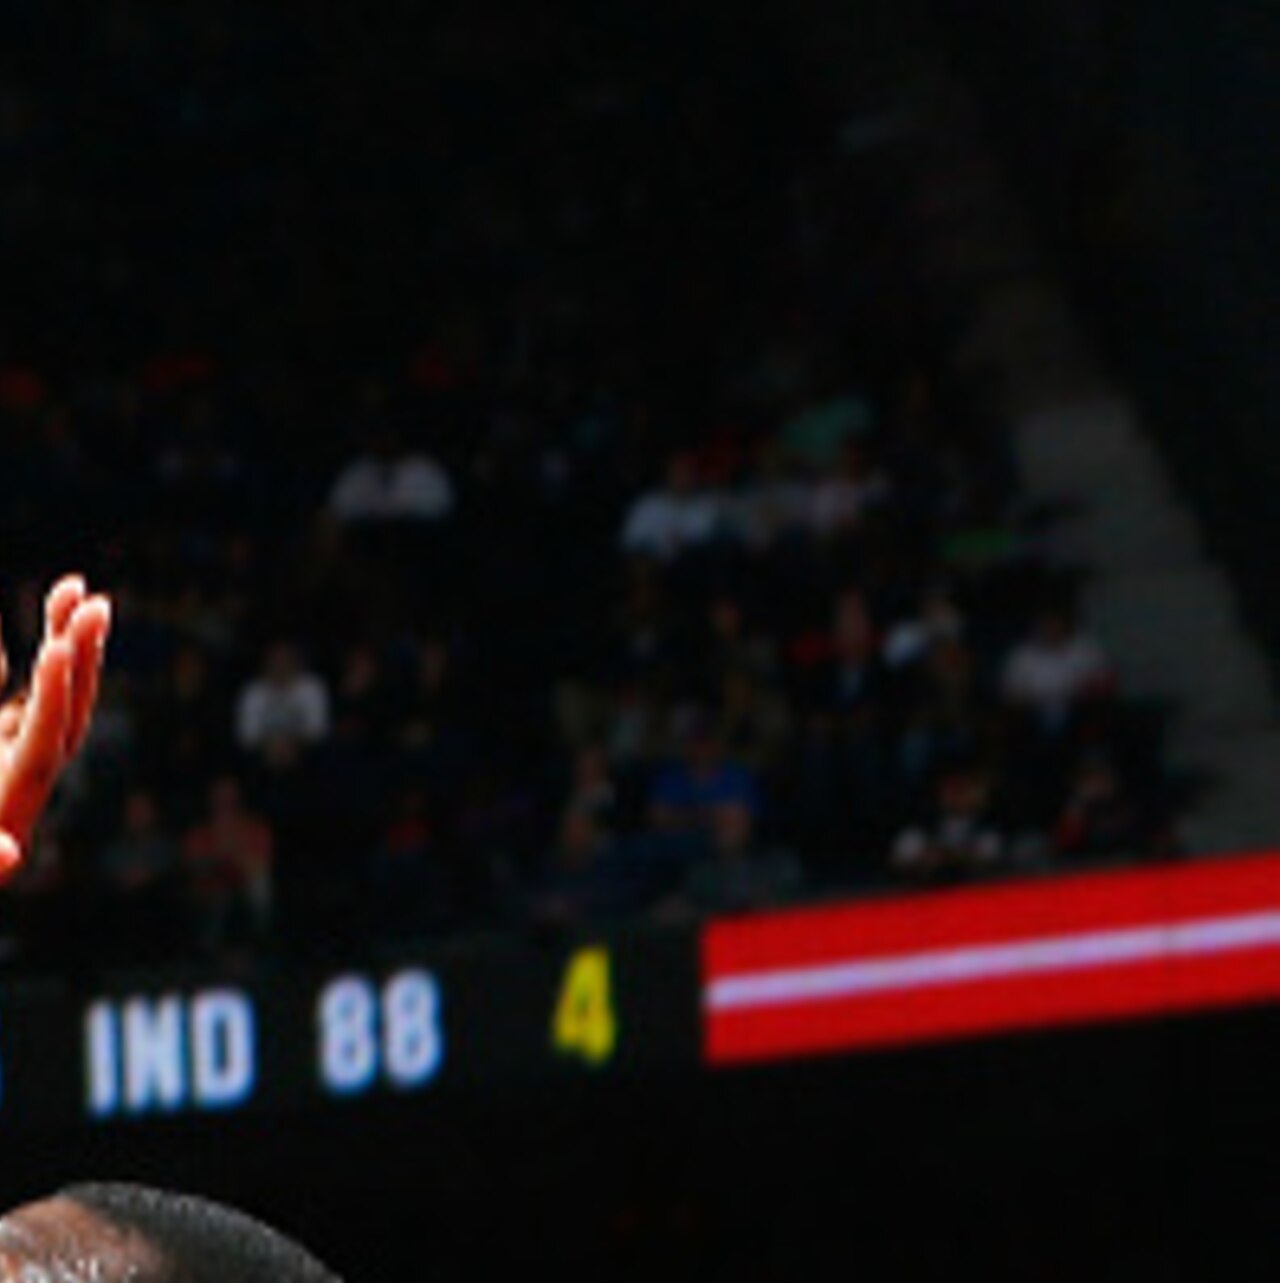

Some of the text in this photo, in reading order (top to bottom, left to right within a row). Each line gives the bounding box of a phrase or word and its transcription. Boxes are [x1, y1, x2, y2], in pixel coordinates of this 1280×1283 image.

[86, 967, 439, 1115] IND 88
[554, 946, 615, 1064] 4
